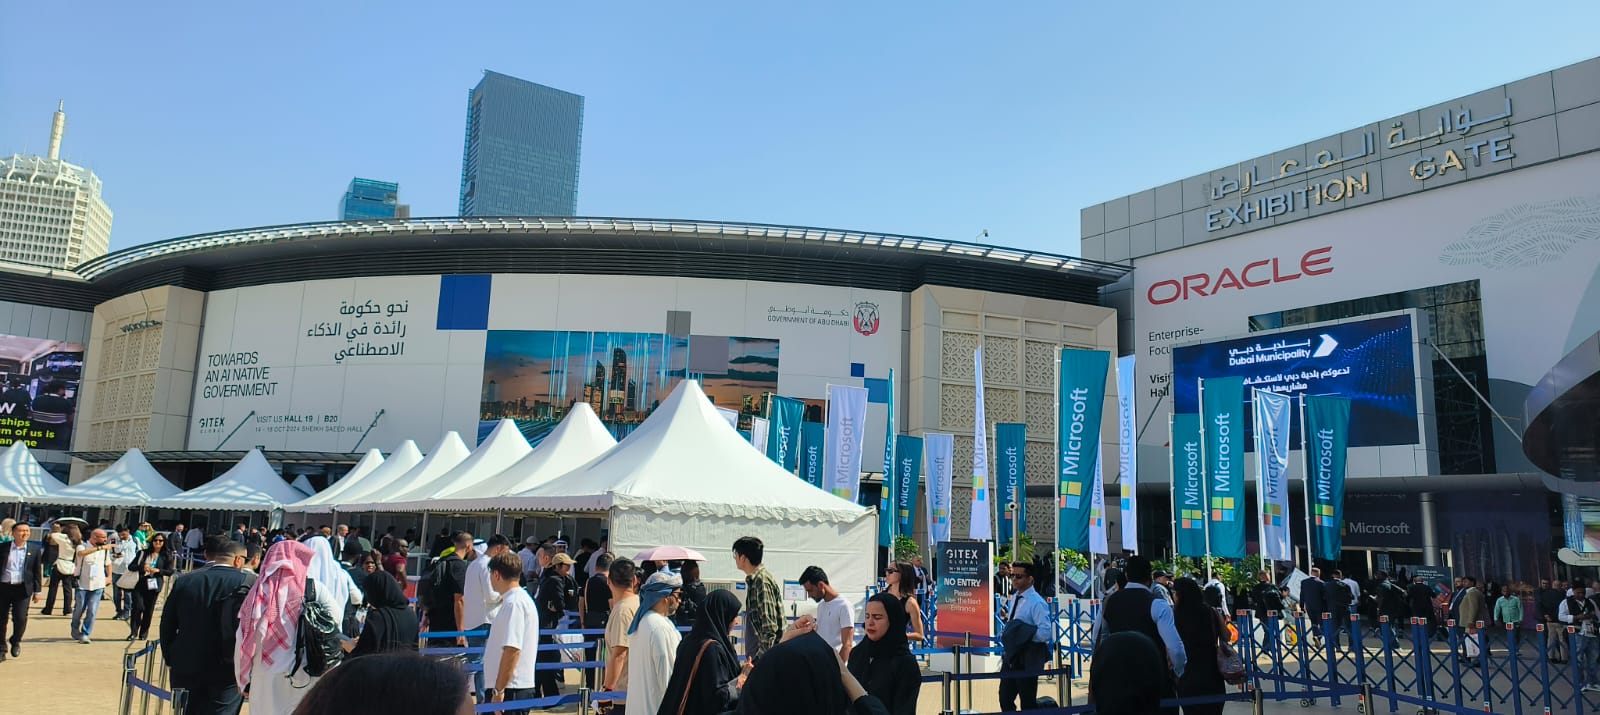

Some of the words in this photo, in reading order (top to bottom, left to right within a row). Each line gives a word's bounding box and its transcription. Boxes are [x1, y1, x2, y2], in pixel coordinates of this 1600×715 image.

[1387, 97, 1513, 149] بوابة
[1206, 170, 1369, 232] EXHIBITION
[1409, 133, 1516, 180] GATE
[1147, 245, 1335, 306] ORACLE
[339, 299, 381, 318] حكومة
[387, 299, 409, 317] نحو
[306, 321, 342, 337] الذكاء
[373, 320, 407, 338] رائدة
[767, 315, 809, 325] GOVERNMENT
[831, 319, 850, 327] DHABI
[346, 321, 368, 343] في
[208, 351, 259, 367] TOWARDS
[334, 341, 405, 364] الاصطناعي
[1229, 355, 1255, 366] Dubai
[1255, 348, 1311, 364] Municipality
[204, 369, 219, 383] AN
[220, 368, 231, 382] AI
[232, 366, 271, 381] NATIVE
[203, 382, 279, 399] GOVERNMENT
[198, 416, 225, 428] GITEX
[256, 415, 272, 424] VISIT
[273, 415, 283, 423] US
[284, 415, 302, 423] HALL
[305, 415, 313, 423] 19
[324, 415, 338, 423] B20
[15, 429, 28, 437] of
[30, 430, 43, 438] us
[45, 430, 55, 438] is
[1062, 387, 1088, 476] Microsoft
[836, 416, 854, 484] Microsoft
[1214, 411, 1230, 493] Microsoft
[1266, 426, 1279, 499] Microsoft
[1317, 427, 1334, 500] Microsoft
[900, 457, 912, 507] Microsoft
[935, 456, 945, 506] Microsoft
[1007, 446, 1017, 500] Microsoft
[1185, 440, 1198, 506] Microsoft
[1350, 522, 1410, 534] Microsoft
[946, 549, 978, 559] GITEX
[943, 577, 956, 586] NO
[957, 578, 982, 587] ENTRY
